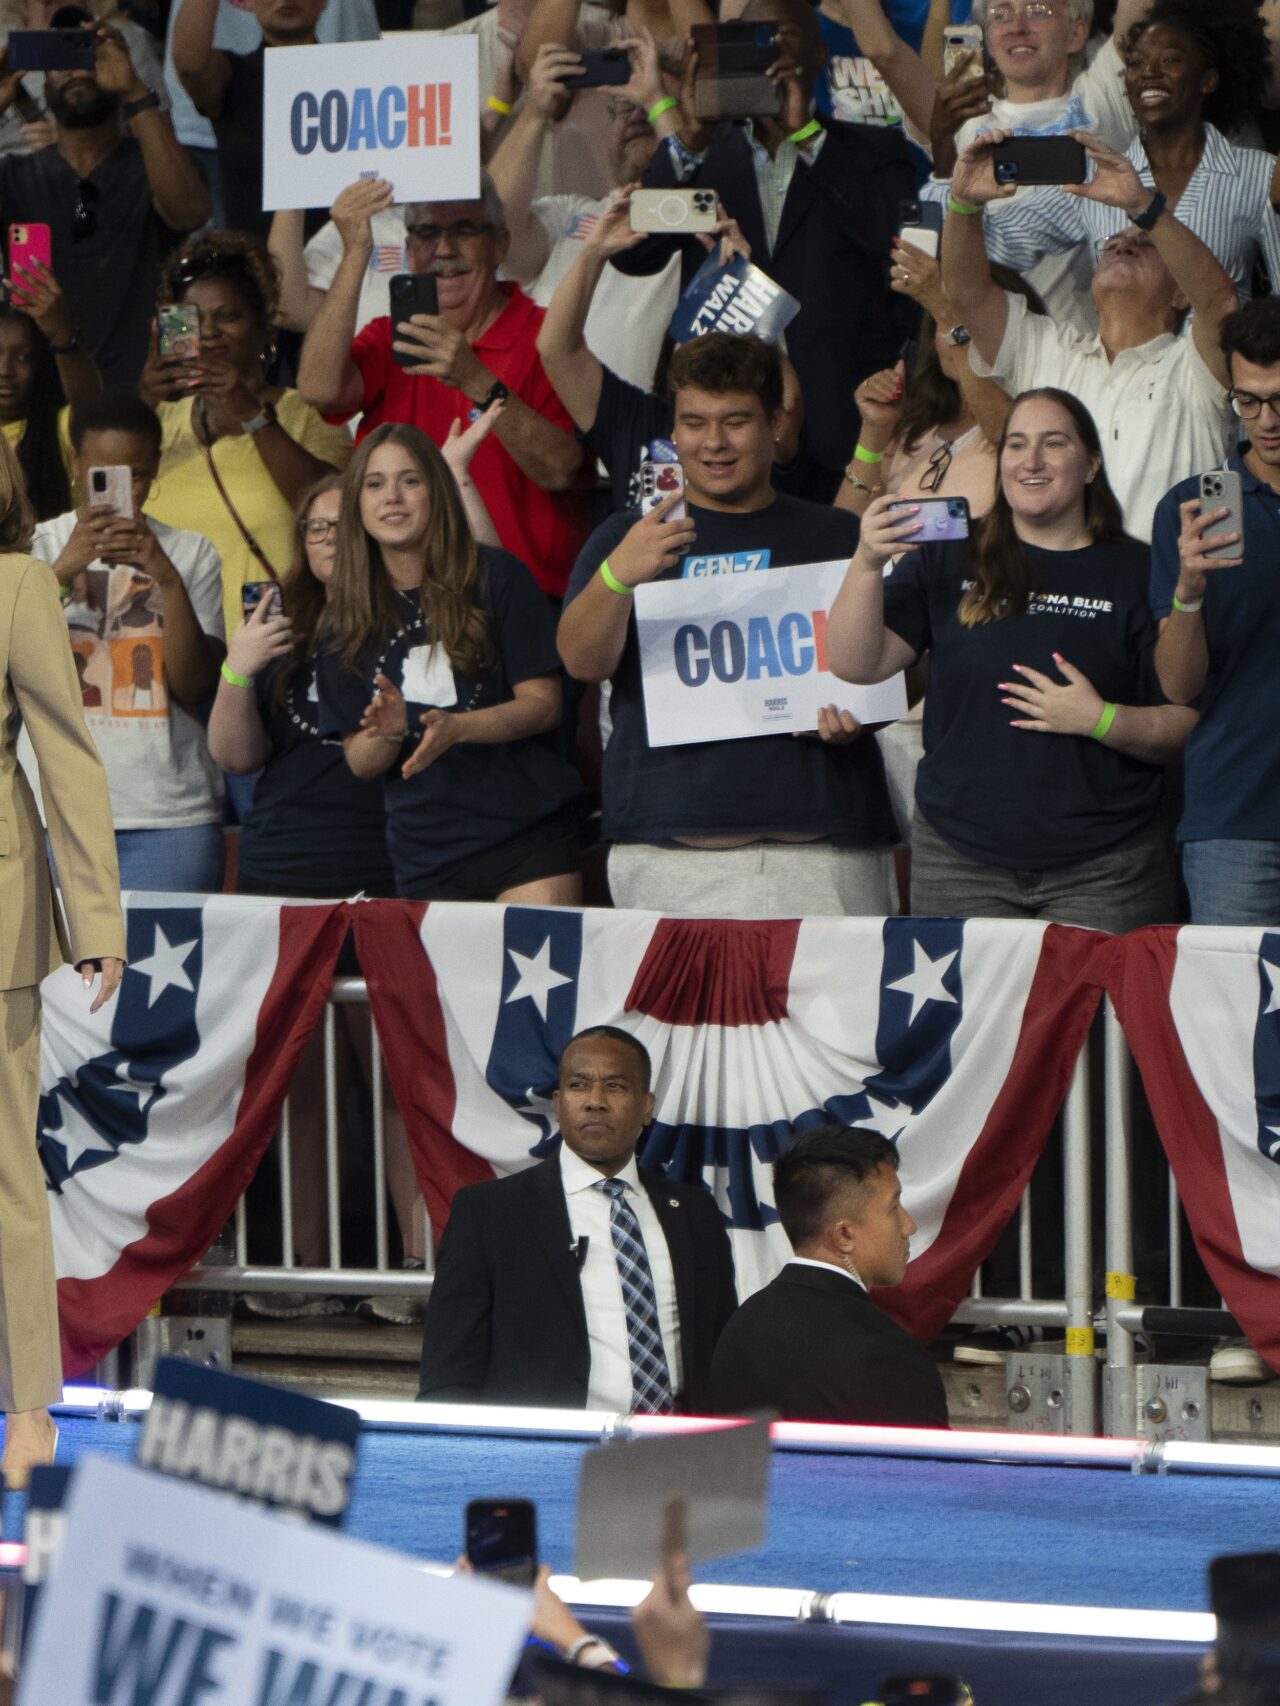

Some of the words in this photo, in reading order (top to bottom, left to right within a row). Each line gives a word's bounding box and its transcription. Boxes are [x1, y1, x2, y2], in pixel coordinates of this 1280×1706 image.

[290, 82, 452, 155] COACH!
[690, 274, 740, 336] WALZ
[1028, 603, 1098, 619] COALITION
[1073, 596, 1114, 612] BLUE
[140, 1398, 353, 1516] HARRIS
[93, 1591, 238, 1705] WE
